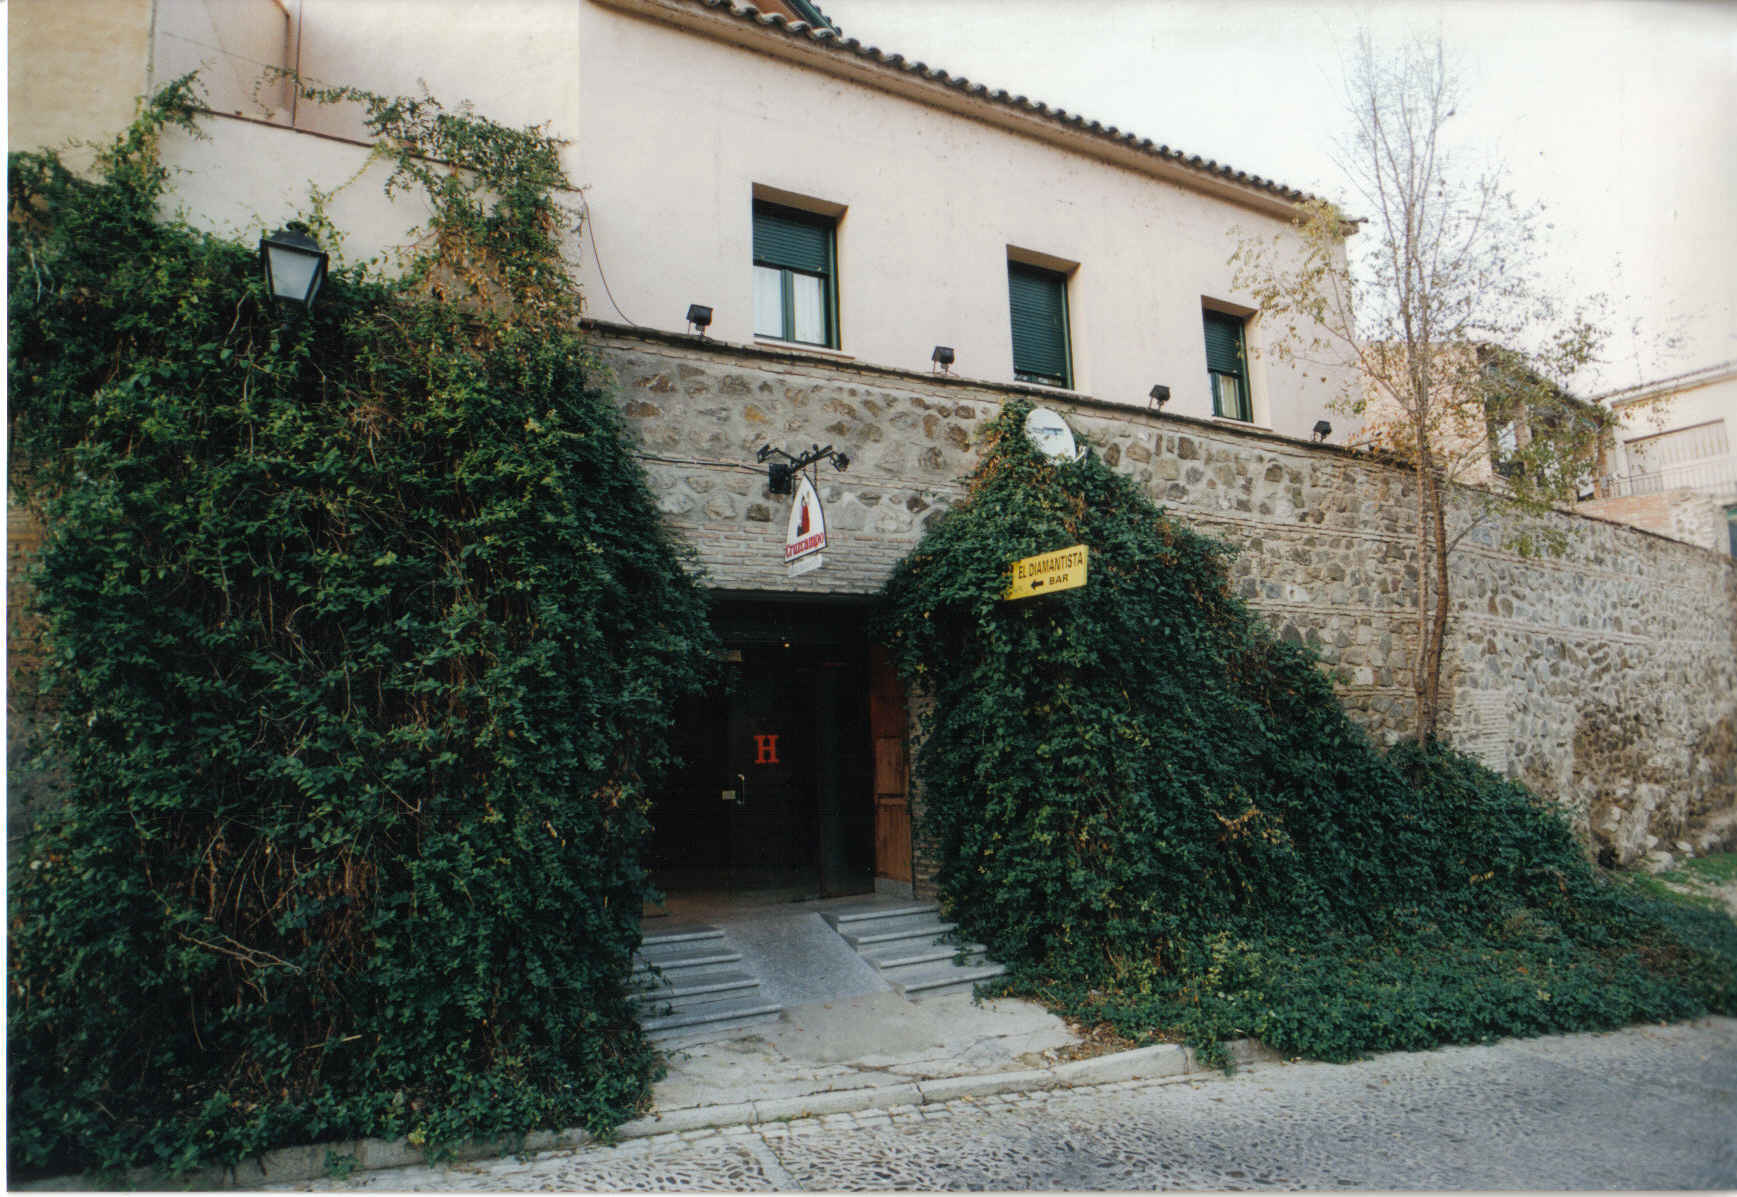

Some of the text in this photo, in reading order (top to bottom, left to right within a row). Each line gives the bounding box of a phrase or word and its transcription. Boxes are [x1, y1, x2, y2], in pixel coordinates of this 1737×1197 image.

[1018, 551, 1083, 579] EL DIAMANTISTA
[1049, 573, 1069, 585] BAR
[753, 734, 780, 764] H
